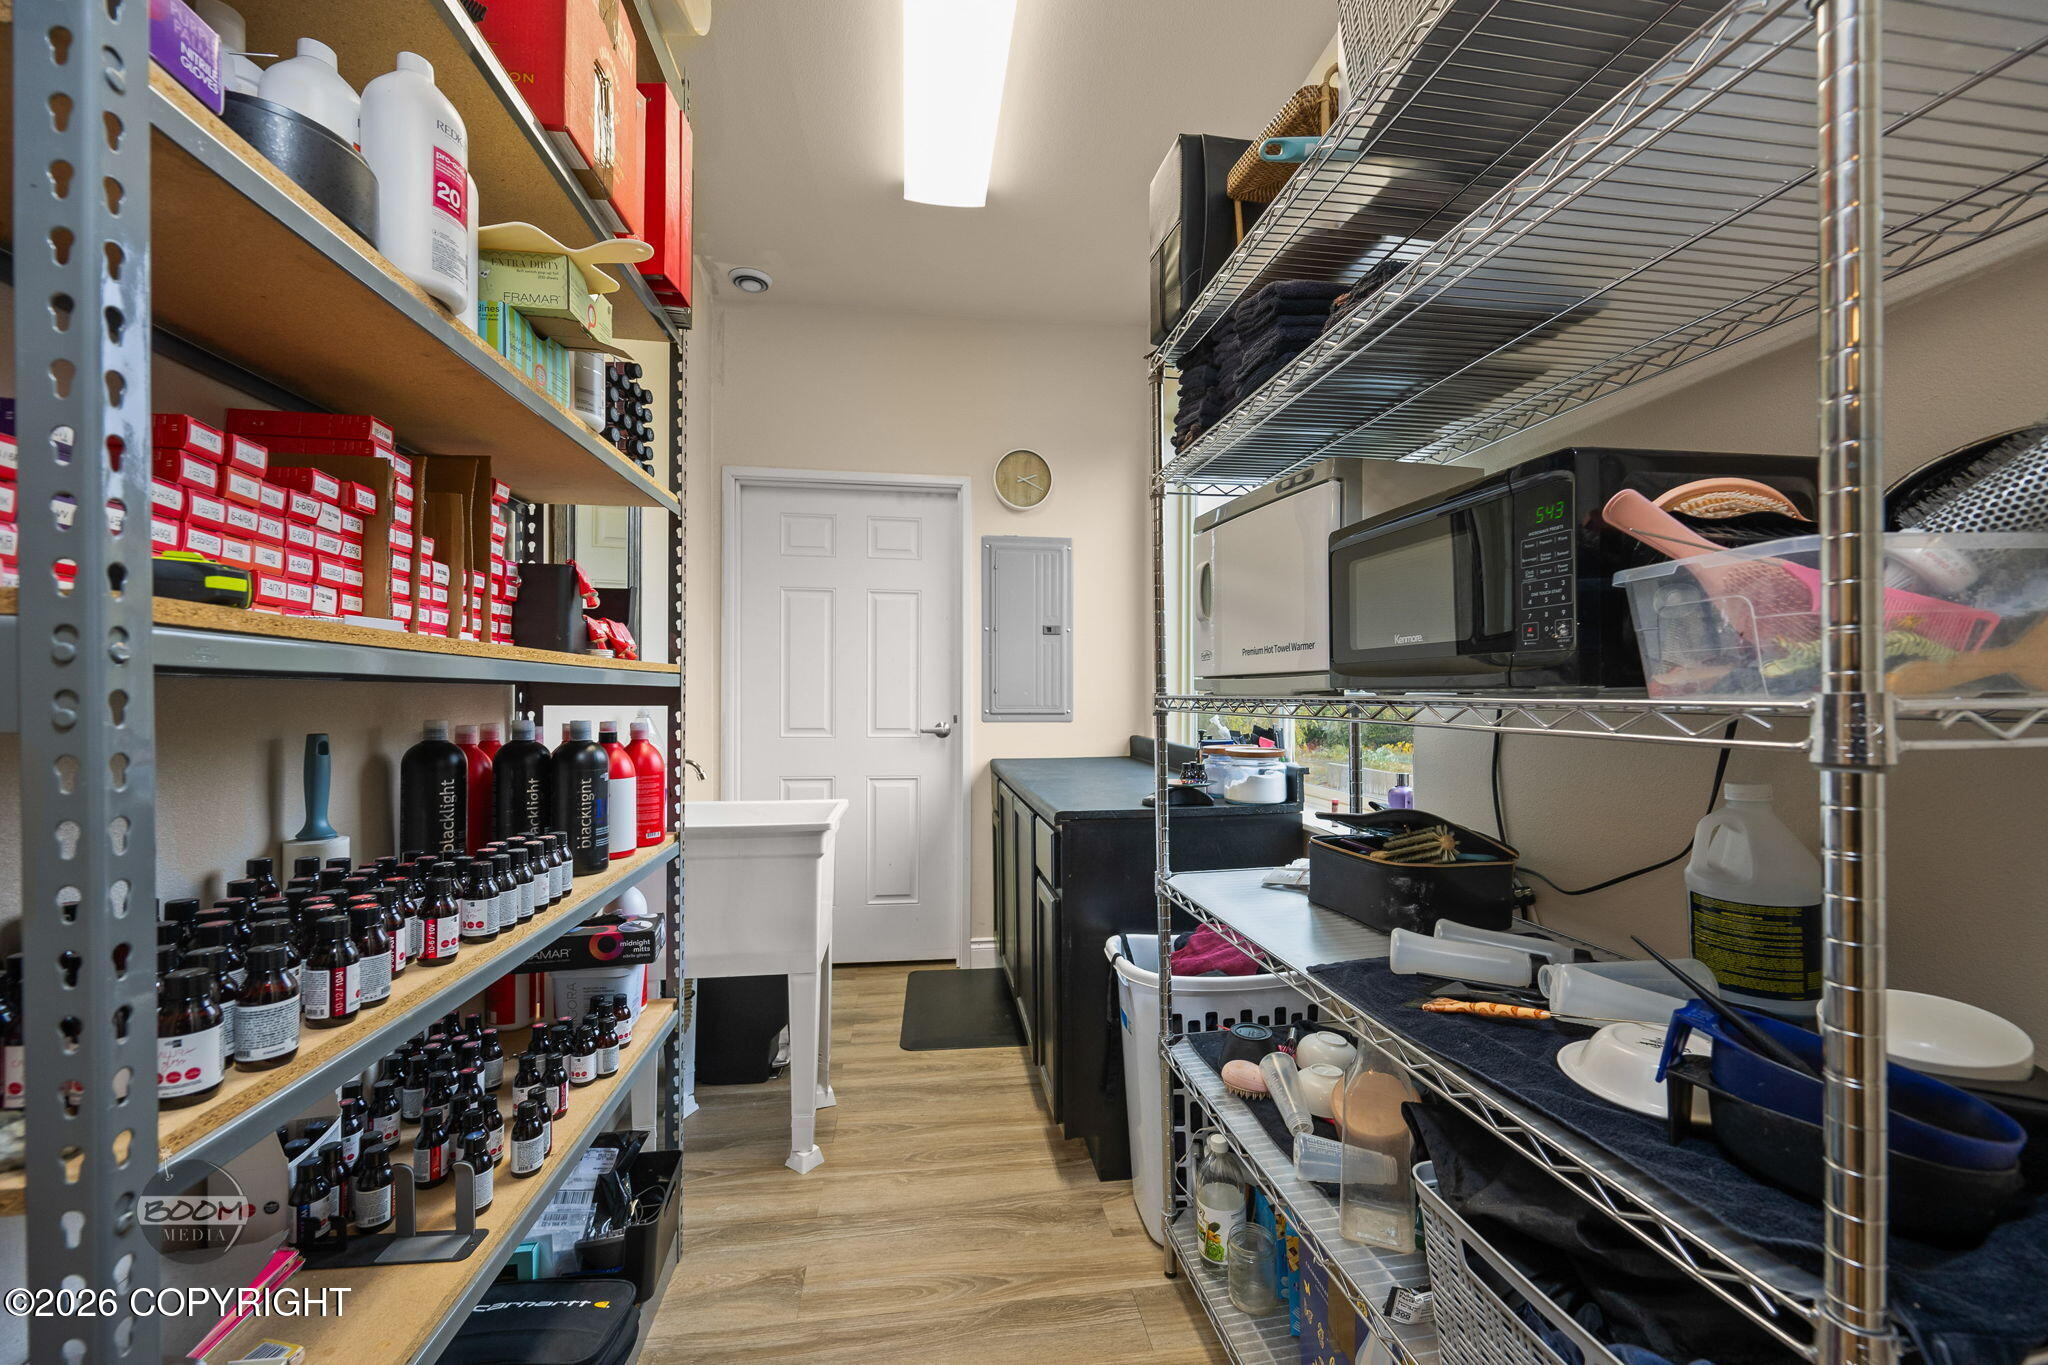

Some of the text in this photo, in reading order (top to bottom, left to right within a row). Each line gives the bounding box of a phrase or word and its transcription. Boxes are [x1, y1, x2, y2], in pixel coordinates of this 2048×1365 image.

[180, 41, 219, 80] NITRILE
[180, 55, 219, 95] GLOVES
[437, 181, 460, 209] 20
[491, 258, 559, 270] EXTRA DIRTY
[503, 292, 559, 304] FRAMAR
[1241, 641, 1315, 657] Premium Hot Towel Warmer
[620, 939, 651, 948] midnight
[633, 945, 650, 953] mitts
[473, 1300, 591, 1312] carhartt
